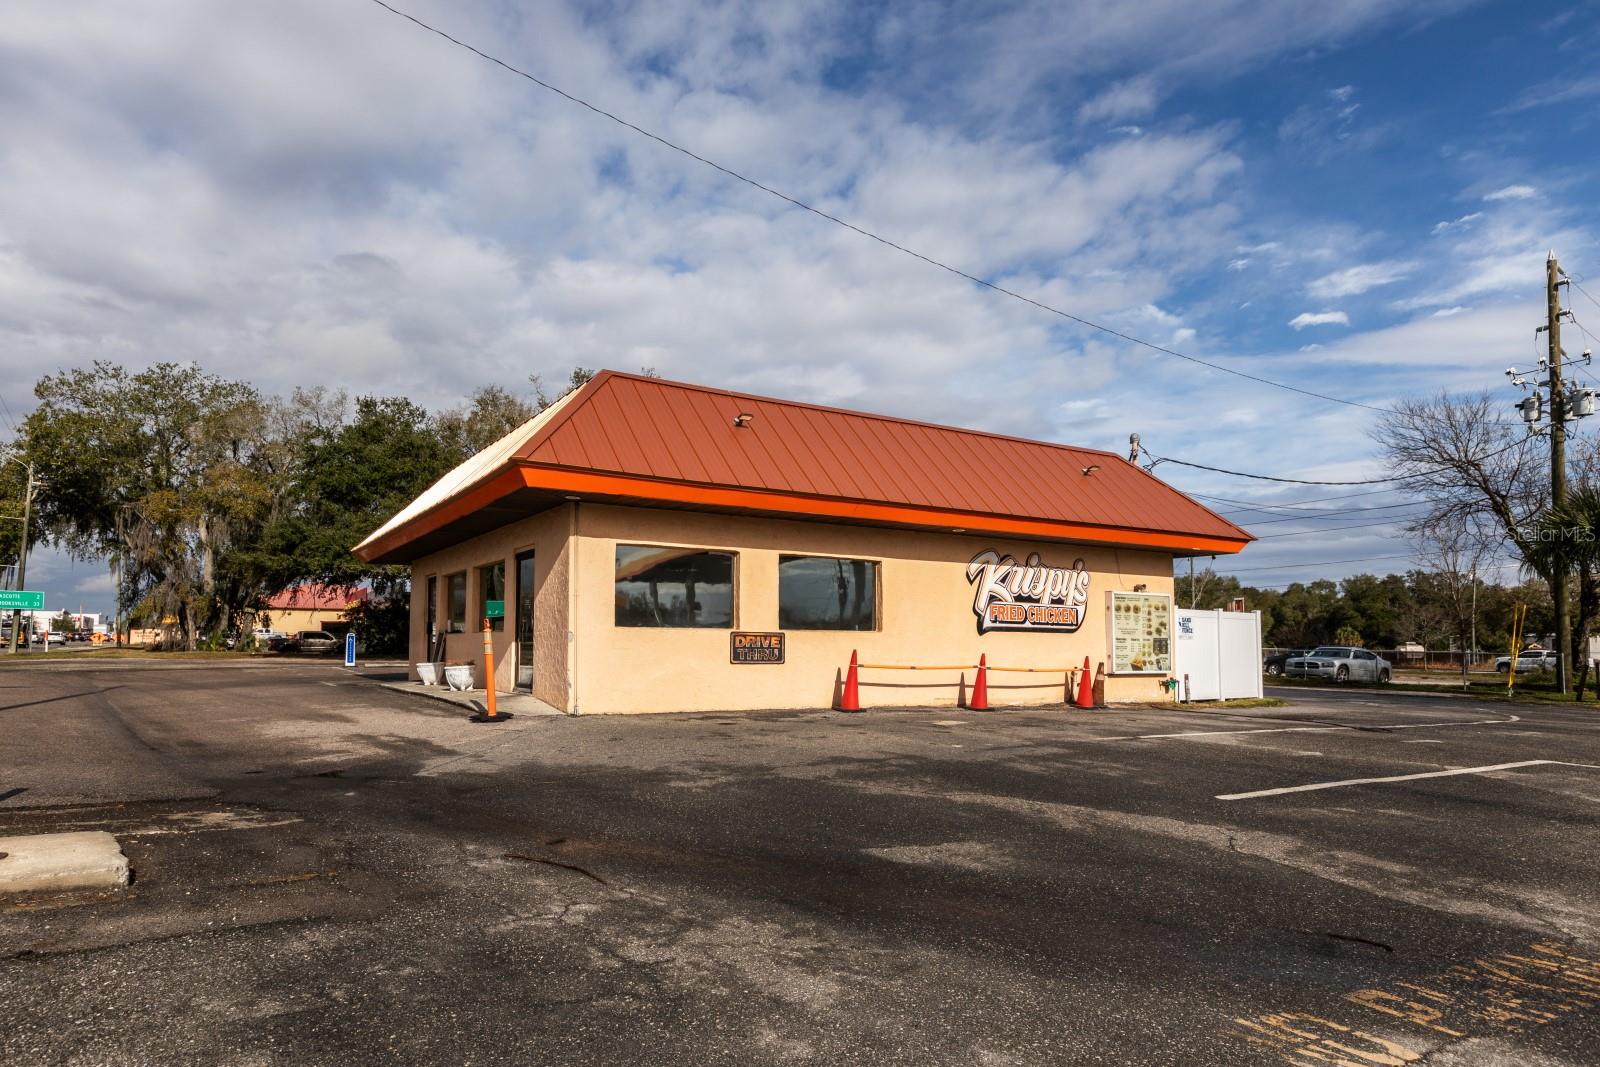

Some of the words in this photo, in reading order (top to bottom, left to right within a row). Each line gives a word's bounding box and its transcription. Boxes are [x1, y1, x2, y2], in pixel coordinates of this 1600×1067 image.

[989, 604, 1027, 622] FRIED
[1027, 606, 1078, 625] CHICKEN
[735, 635, 781, 648] DRIVE
[736, 648, 779, 661] THRU
